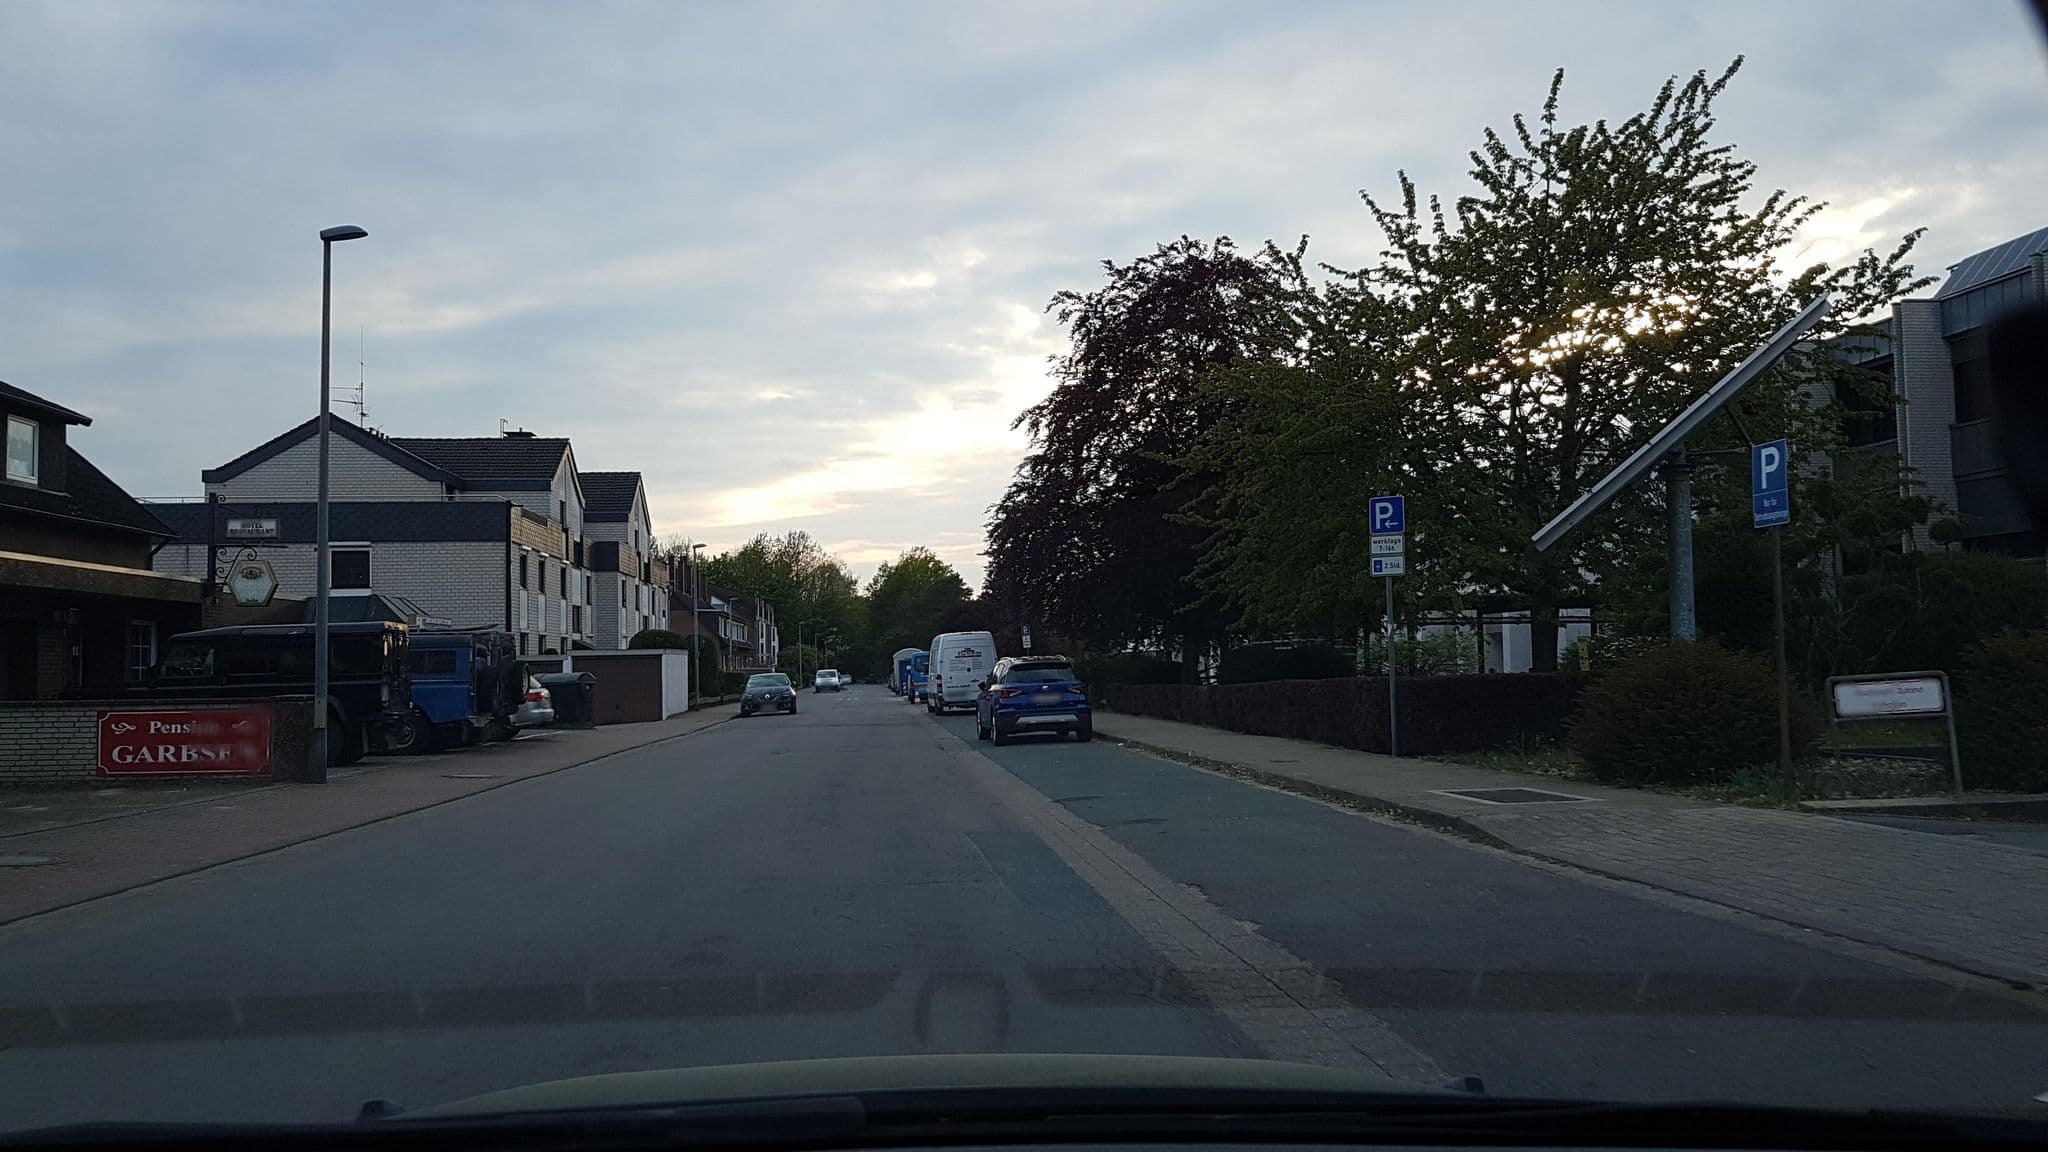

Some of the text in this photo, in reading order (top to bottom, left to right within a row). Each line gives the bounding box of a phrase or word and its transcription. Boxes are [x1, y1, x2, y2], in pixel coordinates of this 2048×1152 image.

[1761, 446, 1780, 490] P
[1375, 502, 1393, 530] P
[150, 719, 219, 735] Pensi
[111, 744, 257, 764] GARBSE
